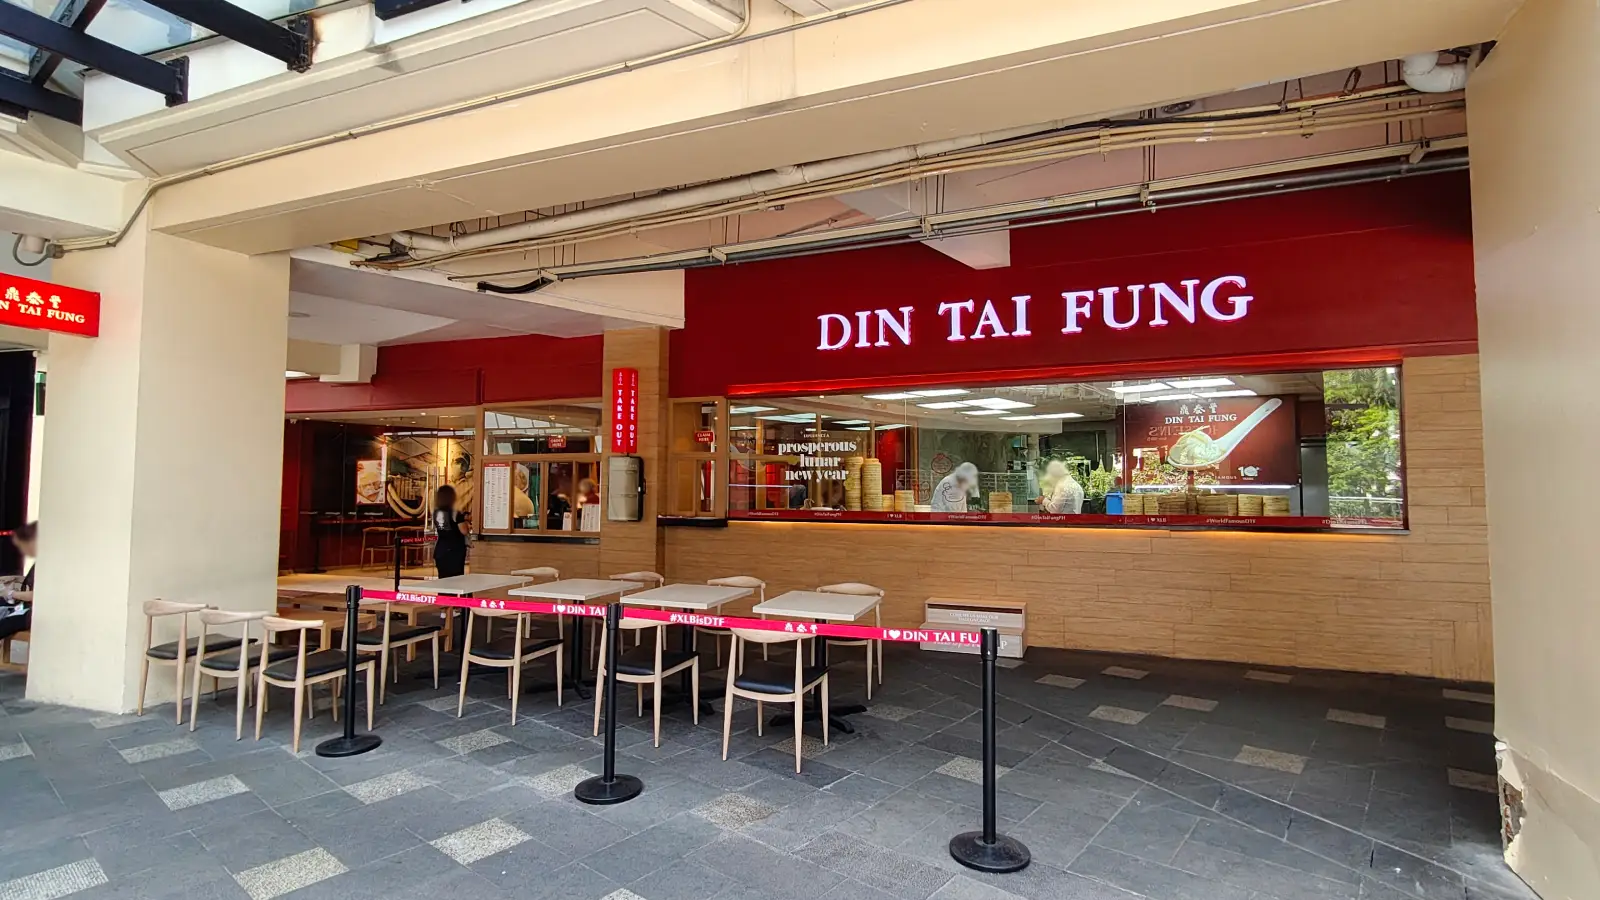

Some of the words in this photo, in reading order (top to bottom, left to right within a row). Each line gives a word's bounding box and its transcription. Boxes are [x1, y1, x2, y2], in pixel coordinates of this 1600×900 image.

[18, 303, 41, 316] TAI
[47, 309, 85, 323] FUNG
[817, 307, 914, 350] DIN
[938, 295, 1032, 342] TAI
[1062, 275, 1254, 334] FUNG
[1165, 416, 1183, 425] DIN
[1188, 415, 1205, 423] TAI
[1208, 413, 1237, 422] FUNG
[778, 441, 857, 456] prosperous
[800, 453, 842, 468] lunar
[785, 470, 815, 481] new
[816, 469, 849, 483] year
[396, 592, 437, 604] #XLBisDTF
[567, 605, 586, 614] DIN
[590, 606, 605, 616] TAI
[670, 613, 725, 627] #XLBisDTF
[902, 630, 929, 641] DIN
[932, 632, 955, 642] TAI
[960, 633, 979, 644] FU
